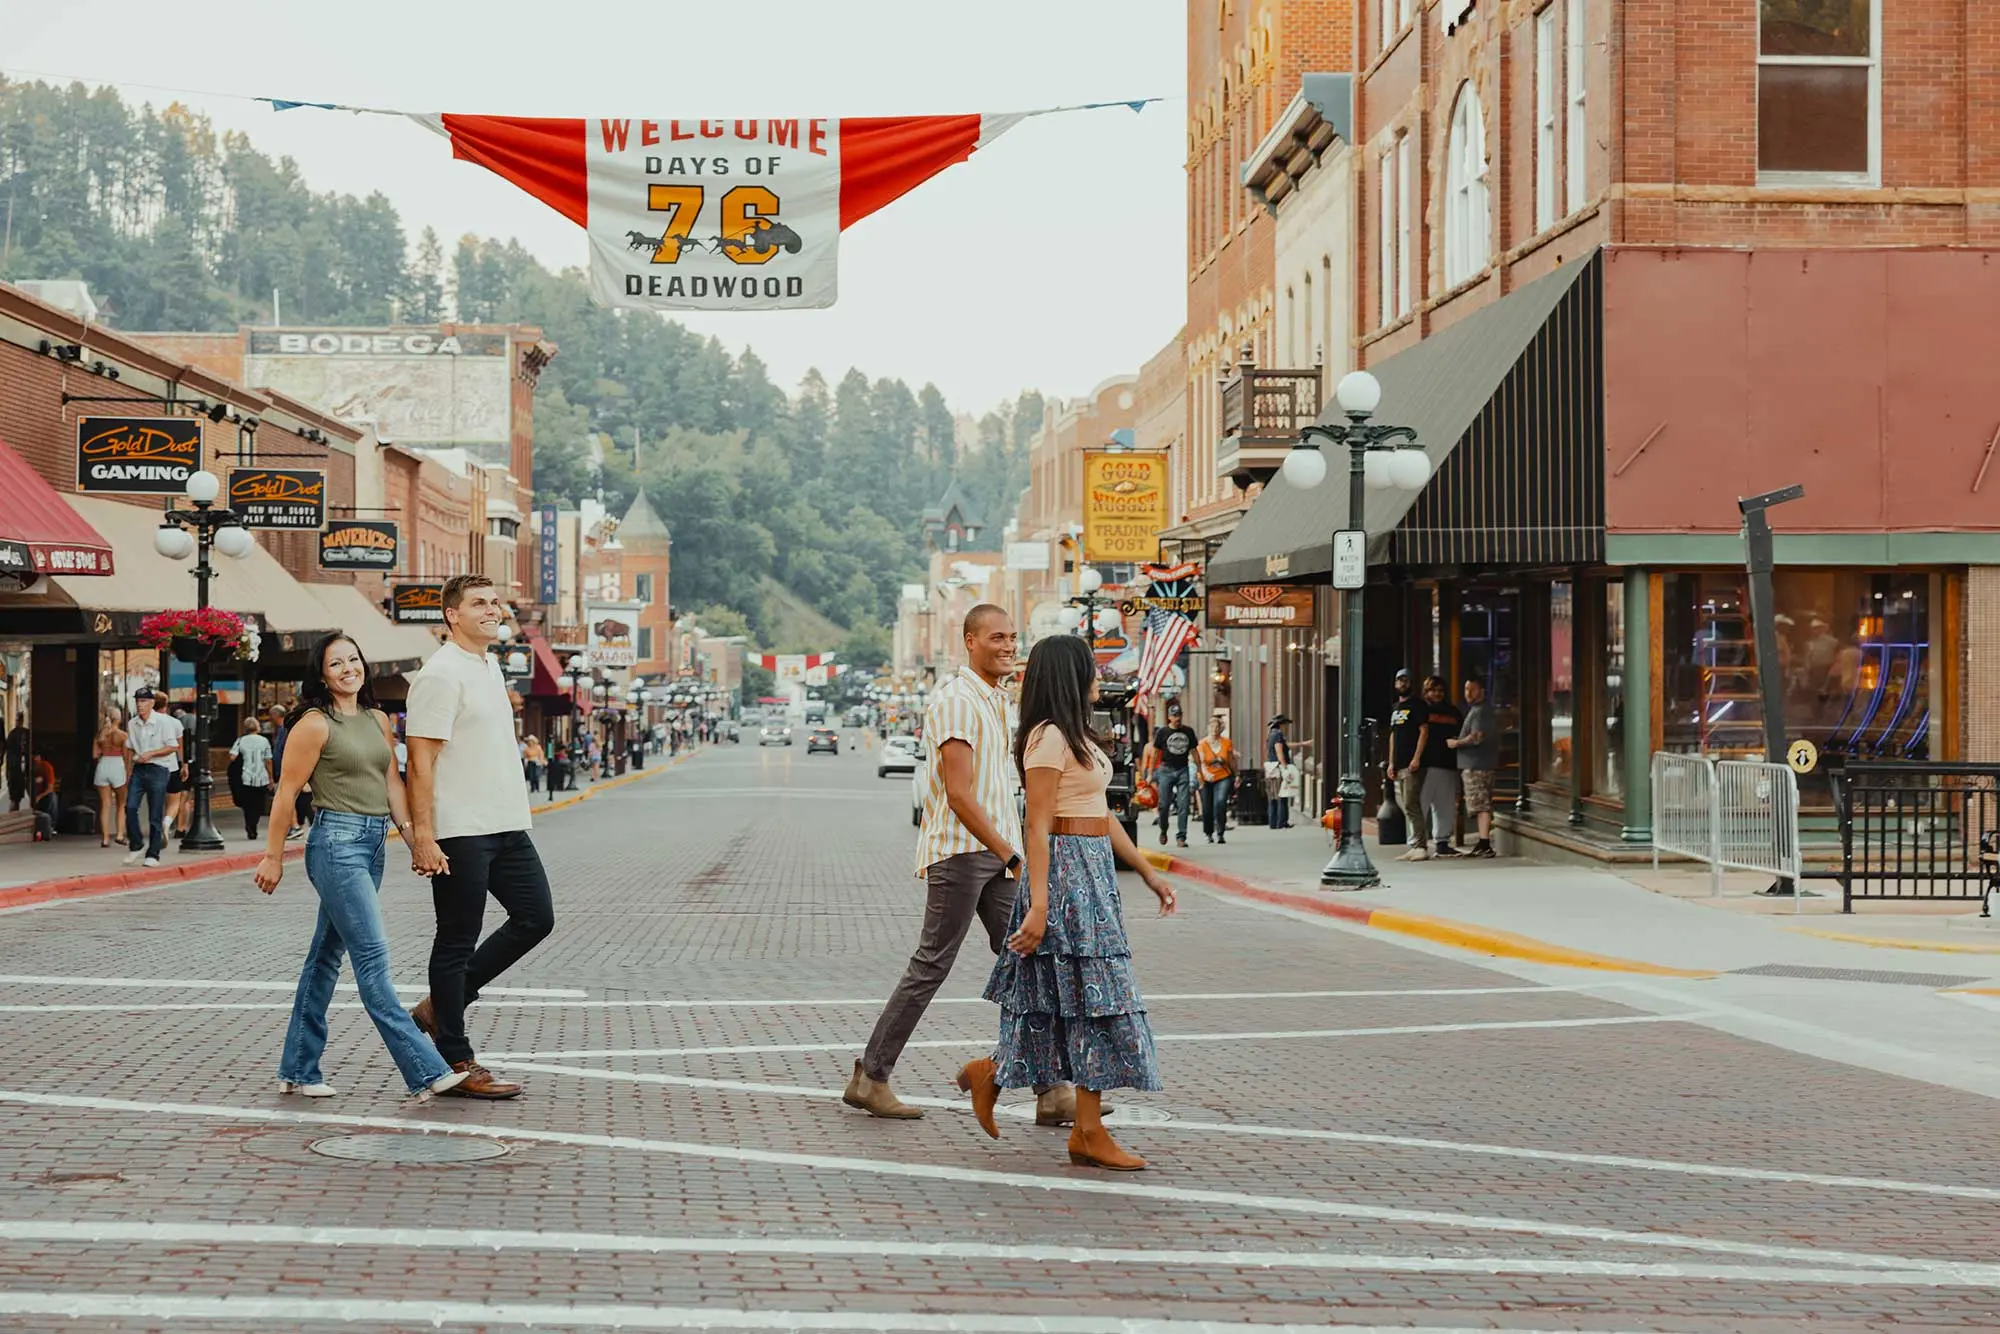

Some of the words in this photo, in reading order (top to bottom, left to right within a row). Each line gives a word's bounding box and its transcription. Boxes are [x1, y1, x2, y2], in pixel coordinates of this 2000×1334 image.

[600, 118, 828, 156] WELCOME
[645, 156, 729, 175] DAYS
[745, 156, 781, 175] OF
[647, 184, 780, 265] 76
[625, 274, 803, 298] DEADWOOD
[279, 333, 463, 355] BODEGA
[82, 426, 144, 455] Gold
[130, 427, 199, 456] Dust
[91, 464, 189, 481] GAMING
[1102, 462, 1151, 481] GOLD
[231, 473, 280, 496] Gold
[268, 474, 323, 497] Dust
[289, 507, 315, 515] SLOTS
[1093, 491, 1158, 512] NUGGET
[243, 515, 264, 523] PLAY
[272, 516, 316, 525] ROULETTE
[322, 527, 396, 549] MAVERICKS
[1104, 539, 1146, 550] POST
[1244, 586, 1278, 600] CYCLES
[1225, 605, 1295, 620] DEADWOOD
[591, 651, 635, 663] SALOON
